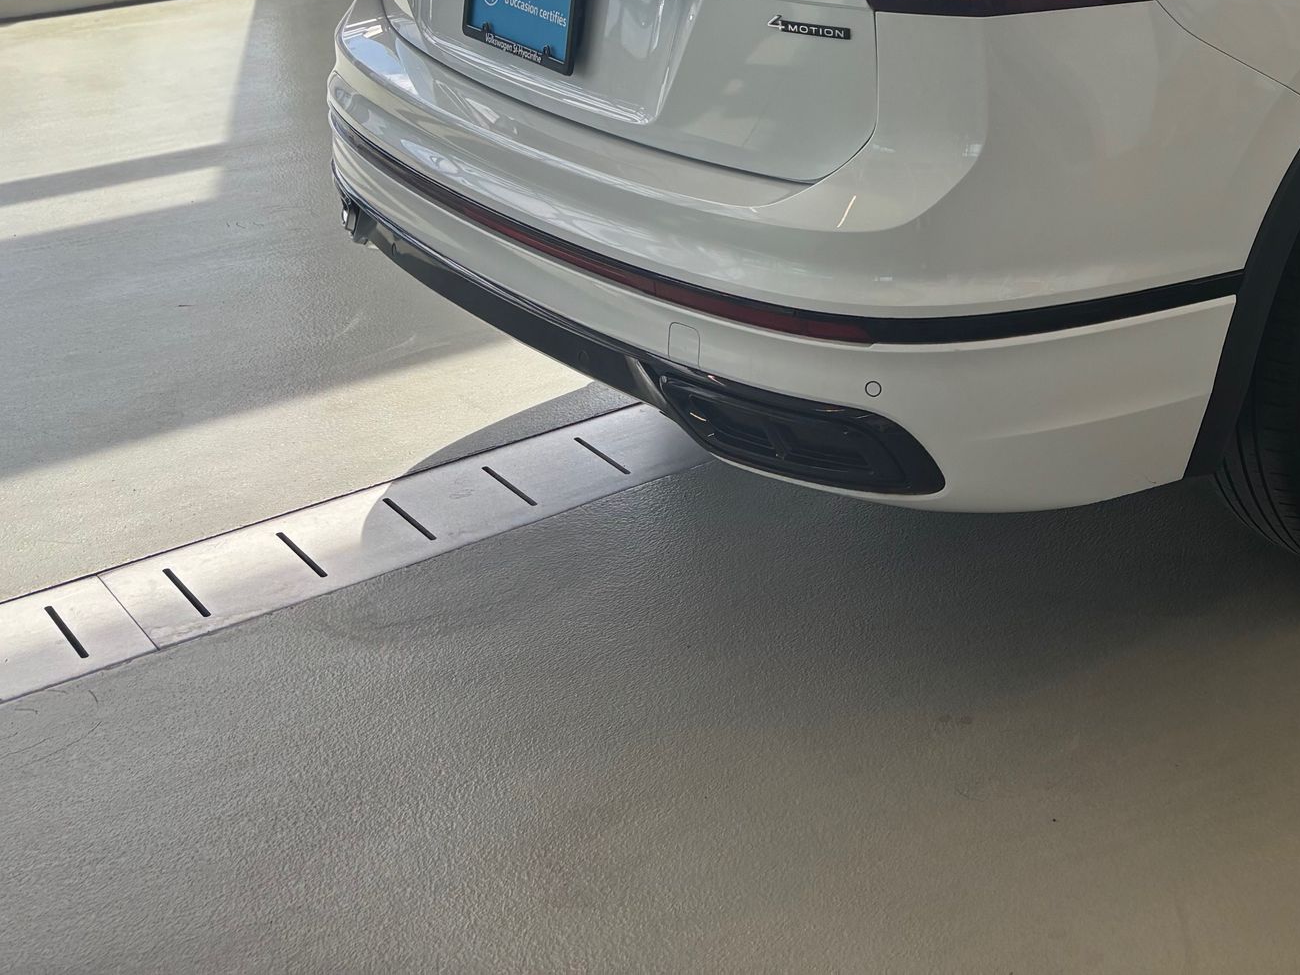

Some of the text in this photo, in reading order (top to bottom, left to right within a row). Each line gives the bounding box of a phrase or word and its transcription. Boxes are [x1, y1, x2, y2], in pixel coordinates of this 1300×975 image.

[539, 8, 567, 27] certifiés
[485, 32, 542, 64] Volkswagen St-Hyacinthe
